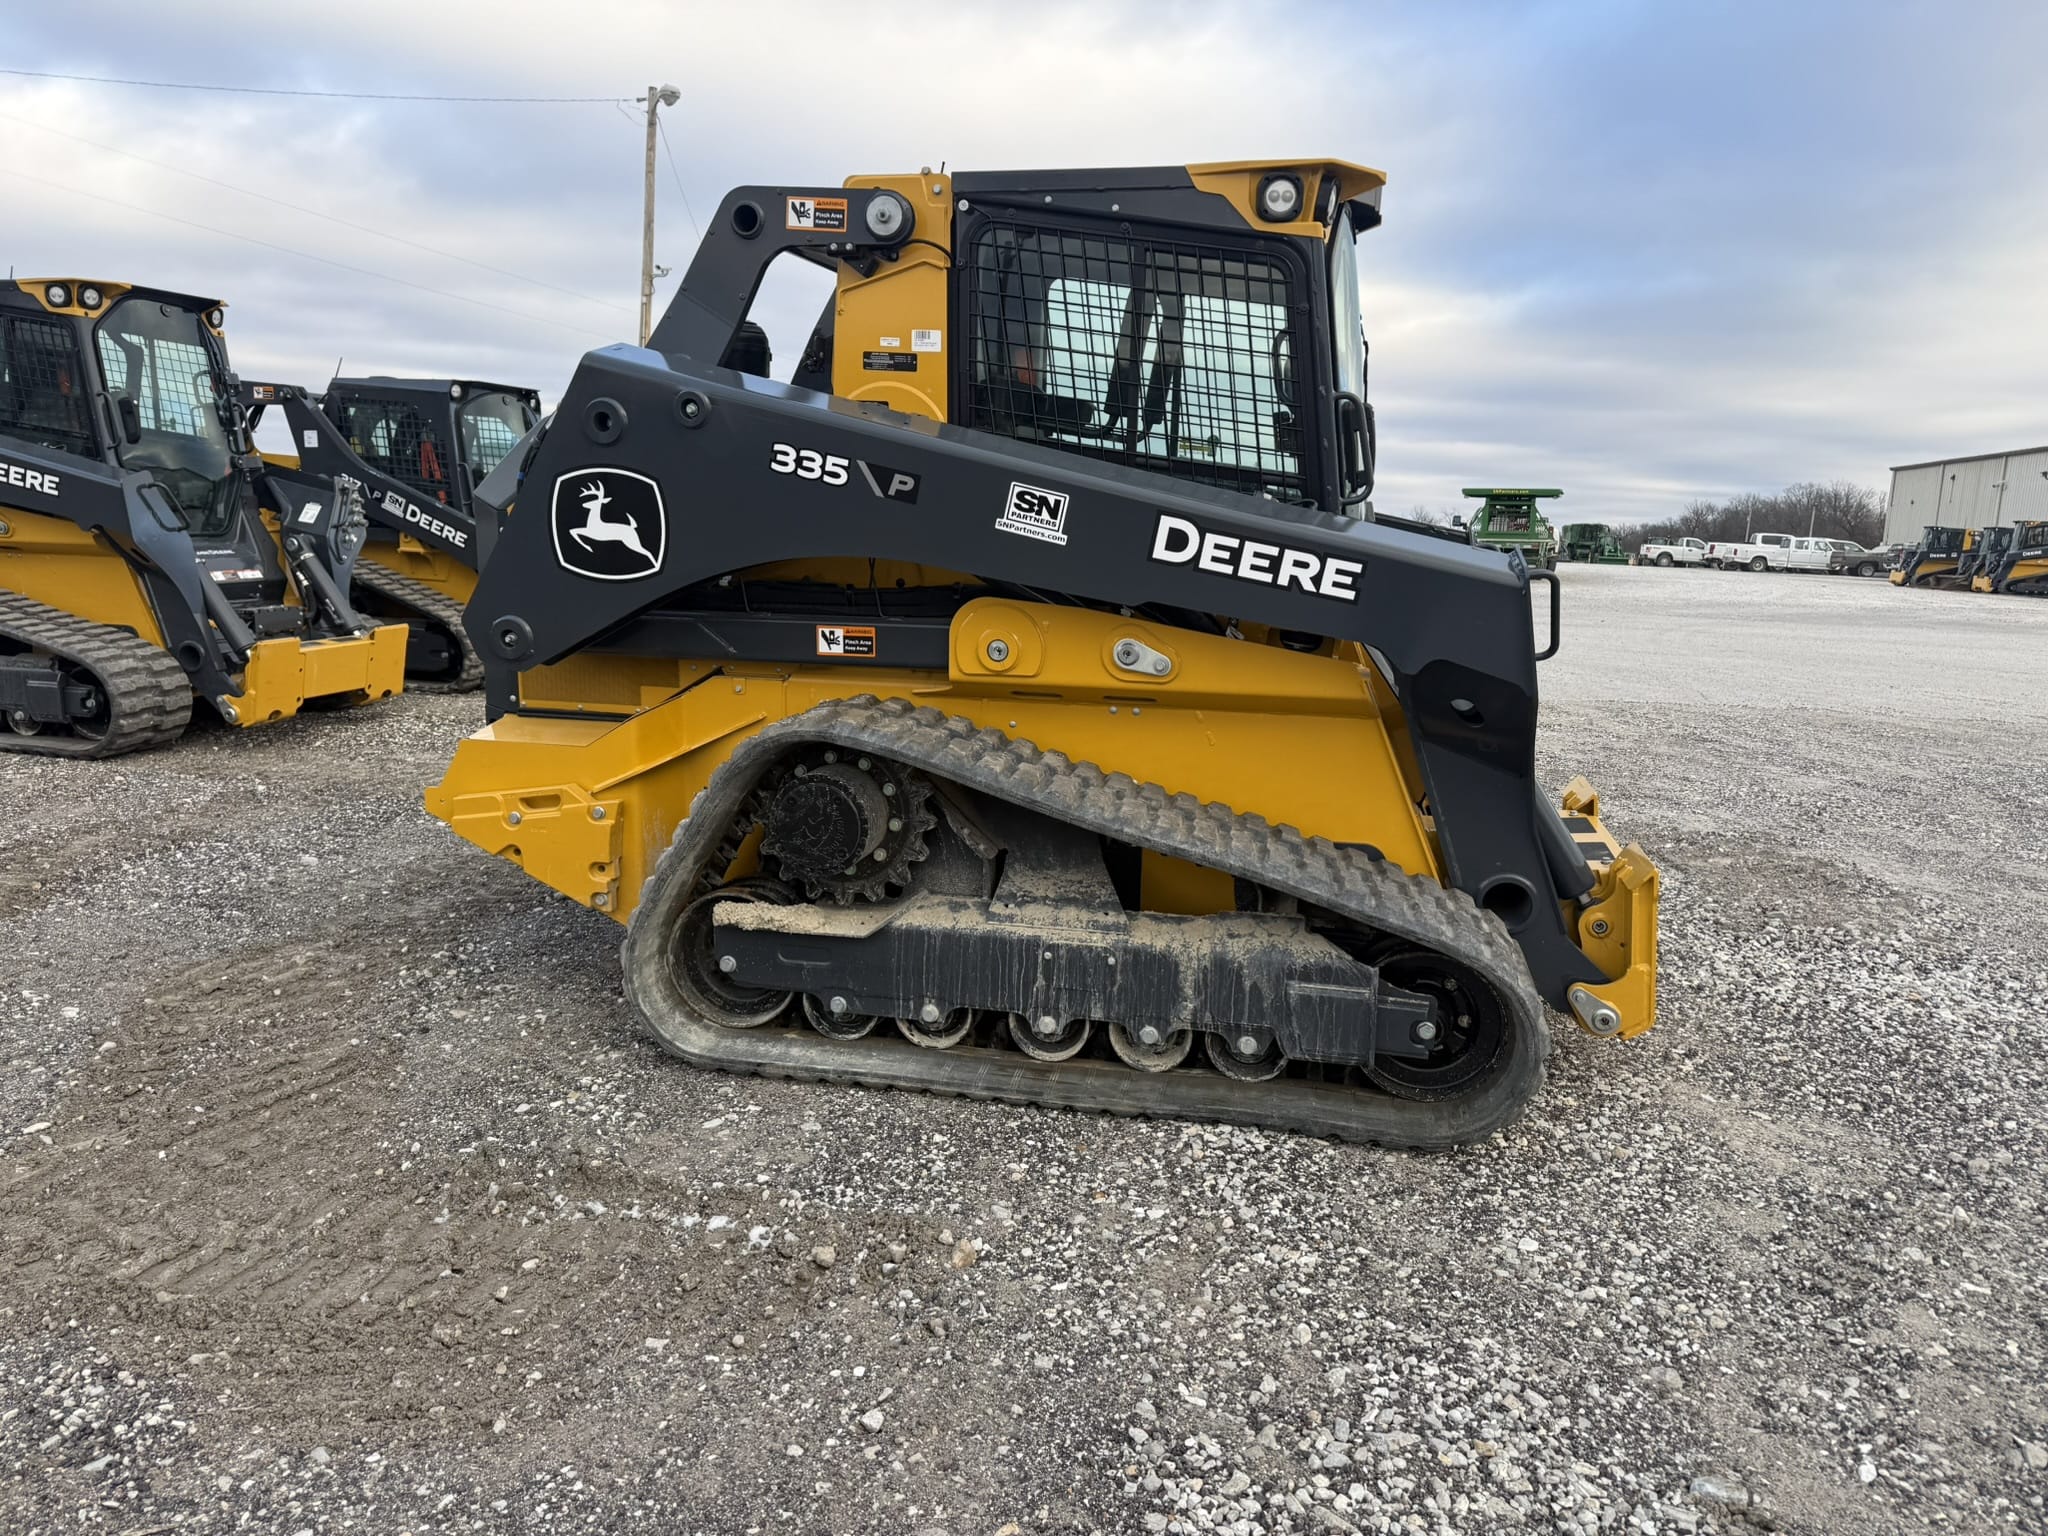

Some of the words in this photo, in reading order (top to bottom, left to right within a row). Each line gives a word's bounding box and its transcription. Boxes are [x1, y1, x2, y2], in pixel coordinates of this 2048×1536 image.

[770, 443, 849, 486] 335
[405, 503, 468, 548] DEERE
[997, 520, 1066, 543] SNPartners.com
[1010, 511, 1057, 528] PARTNERS
[1152, 514, 1363, 601] DEERE
